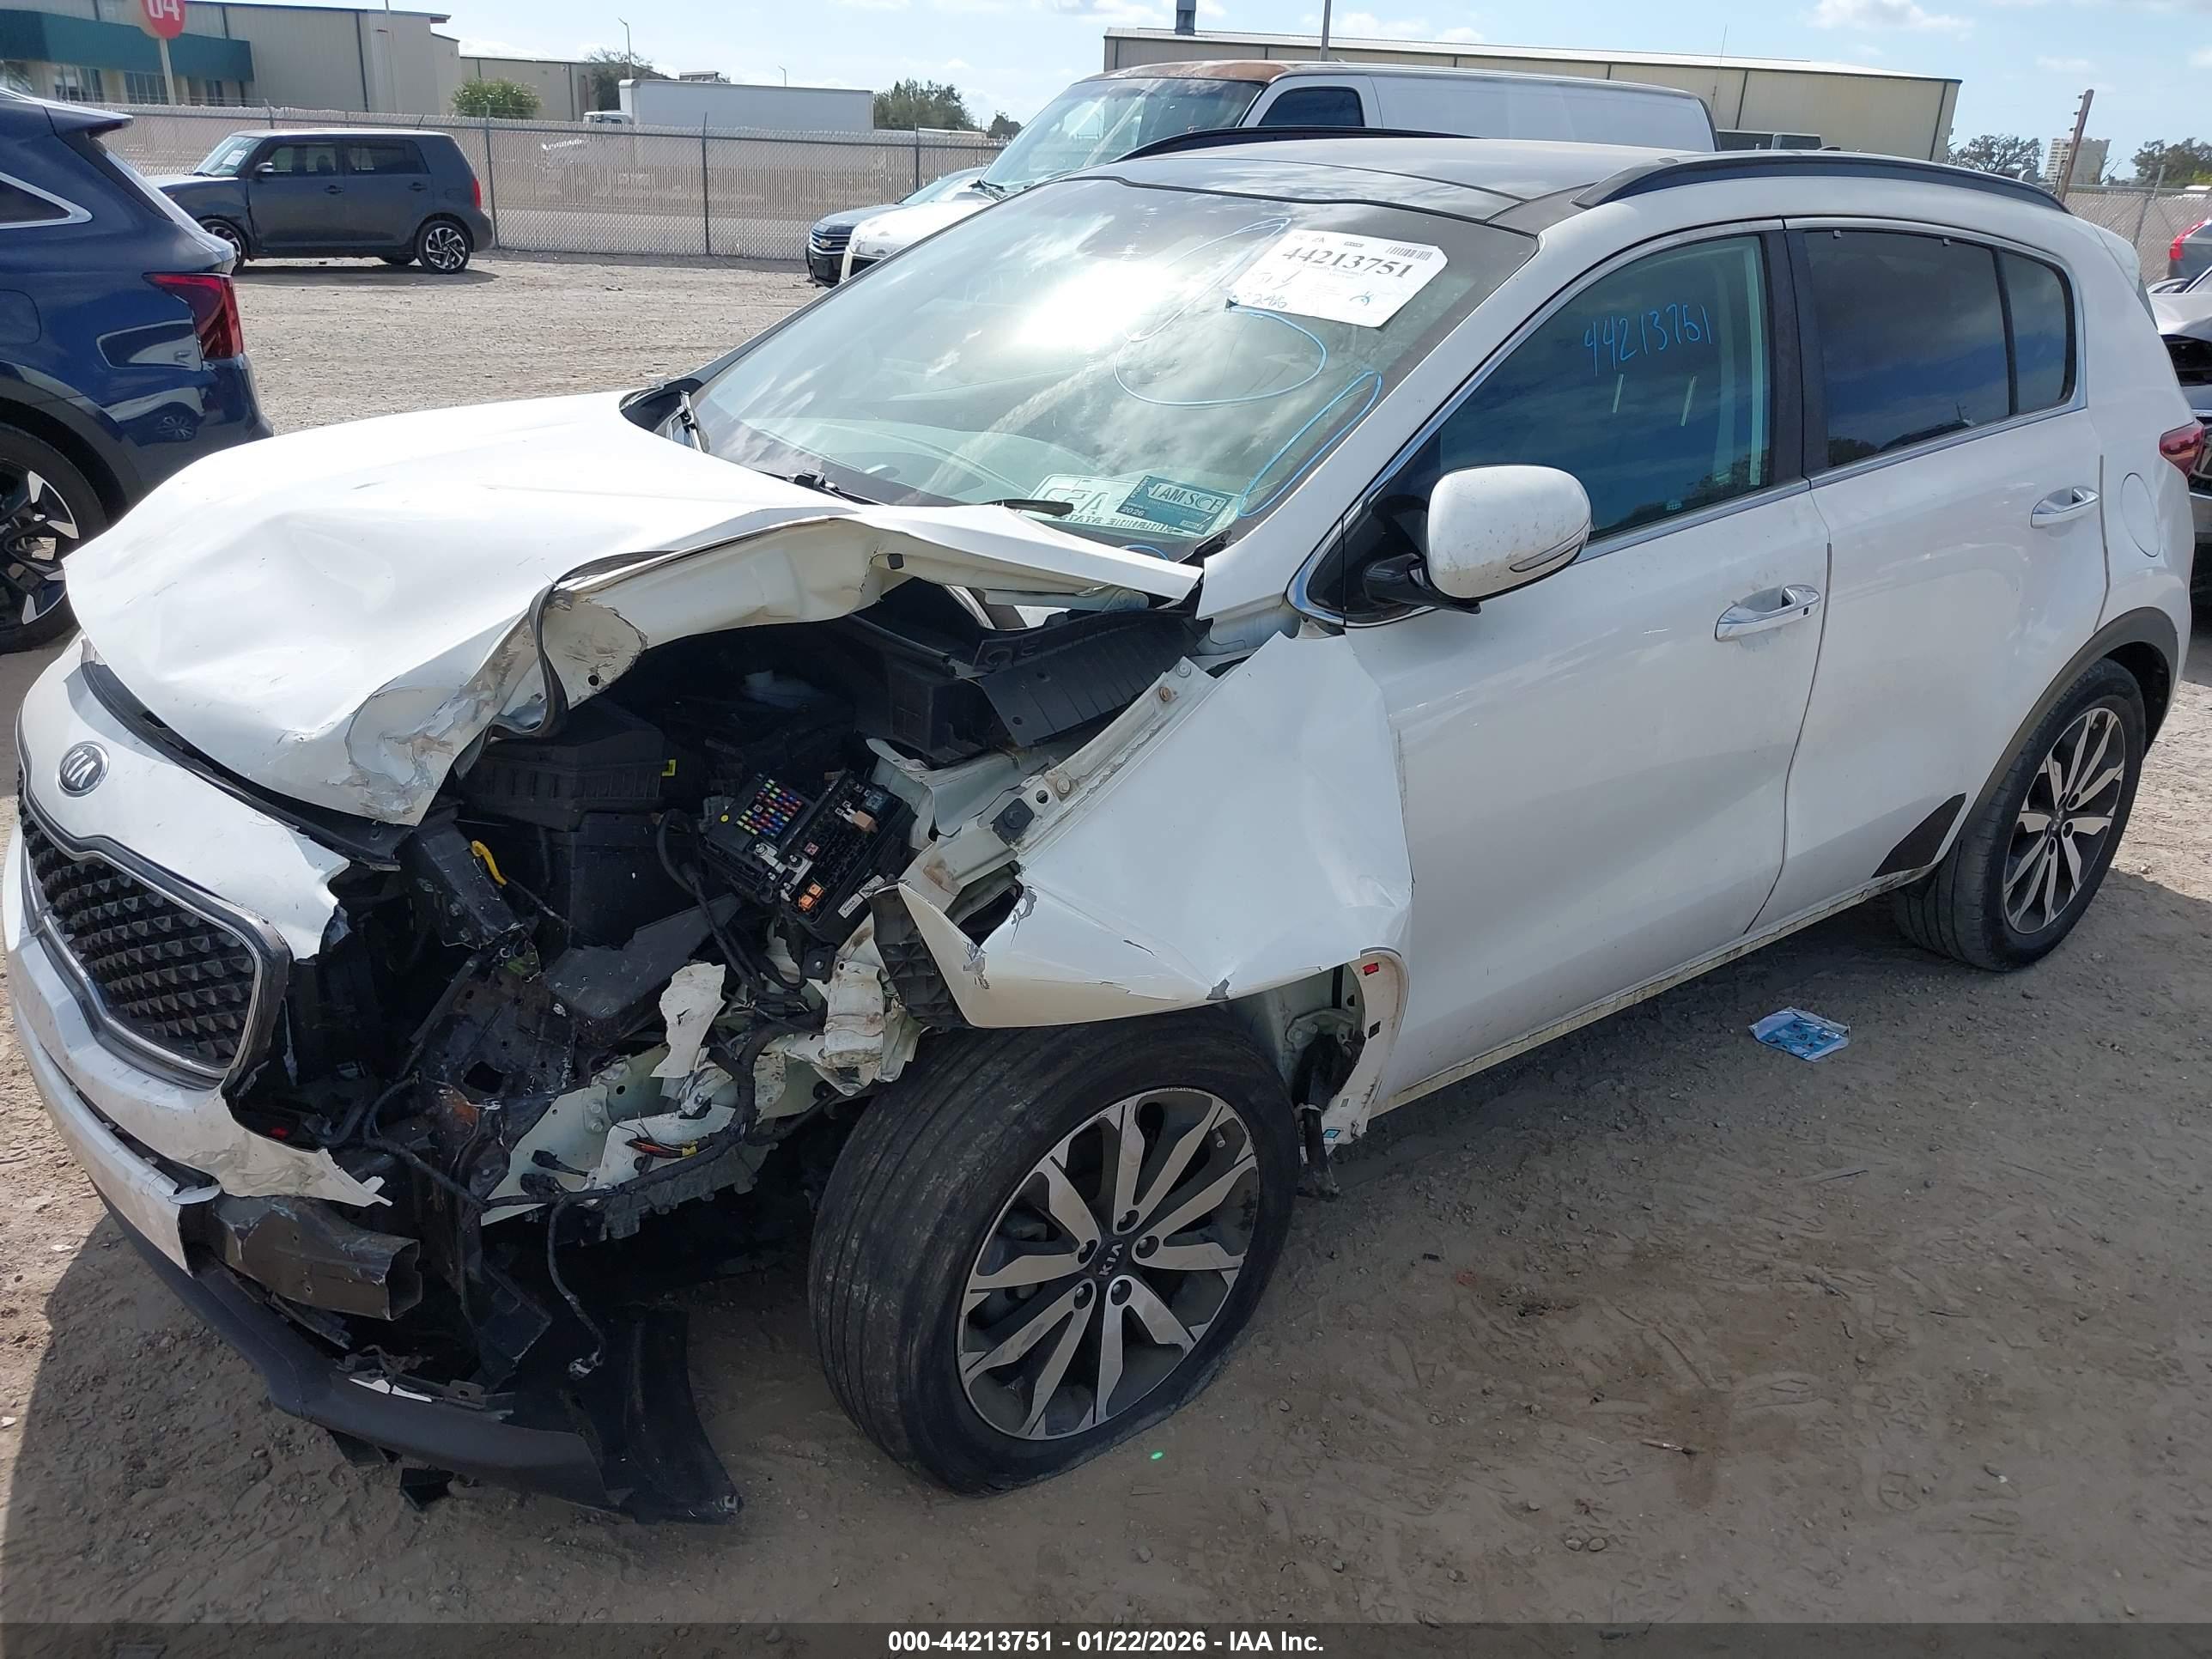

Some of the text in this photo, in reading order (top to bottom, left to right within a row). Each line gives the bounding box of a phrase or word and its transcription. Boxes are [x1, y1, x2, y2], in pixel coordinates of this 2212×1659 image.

[1281, 246, 1414, 278] 44213751
[1152, 483, 1162, 496] I
[1158, 486, 1185, 503] AM
[1121, 505, 1146, 517] 2026
[60, 747, 97, 788] KIA
[1098, 1243, 1123, 1276] KIA
